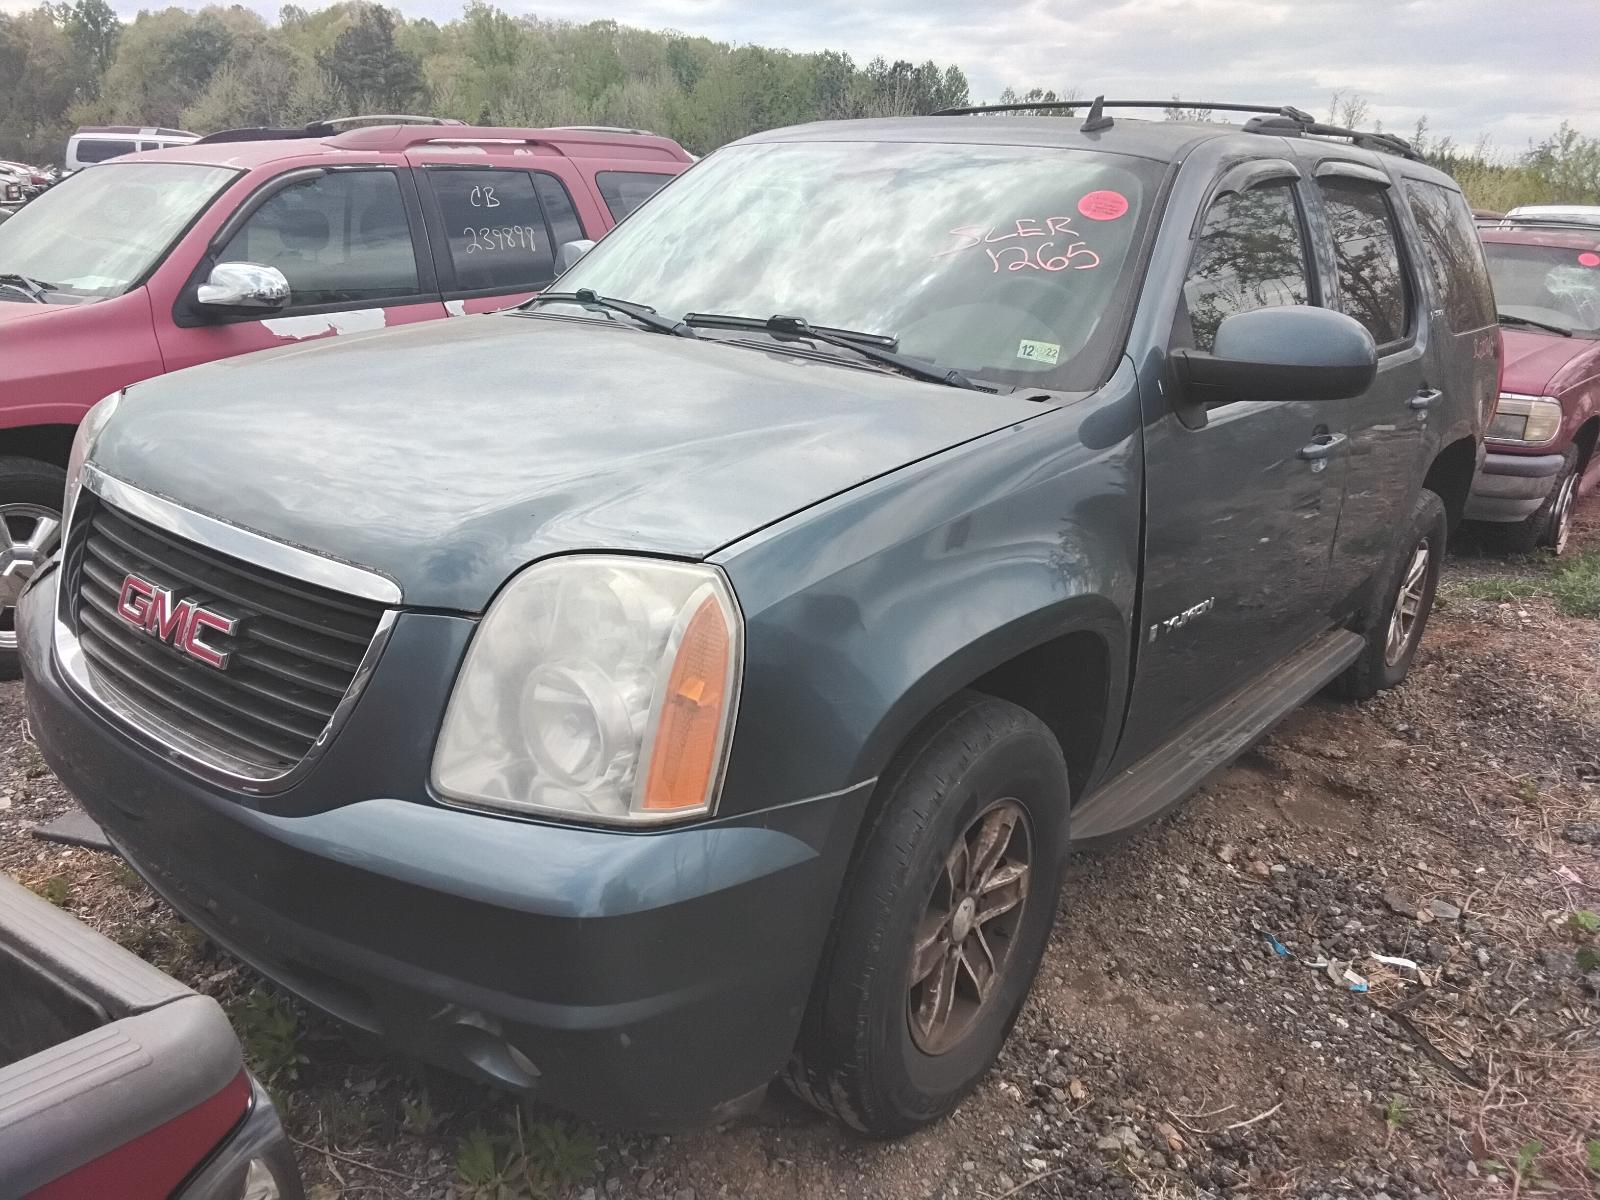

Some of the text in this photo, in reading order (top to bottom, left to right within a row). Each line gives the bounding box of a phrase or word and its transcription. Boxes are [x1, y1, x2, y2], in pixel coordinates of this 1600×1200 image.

[470, 185, 500, 207] CB
[985, 241, 1101, 273] 1265
[1022, 344, 1058, 358] 12 22
[117, 573, 238, 671] GMC
[1162, 596, 1216, 634] YUKON
